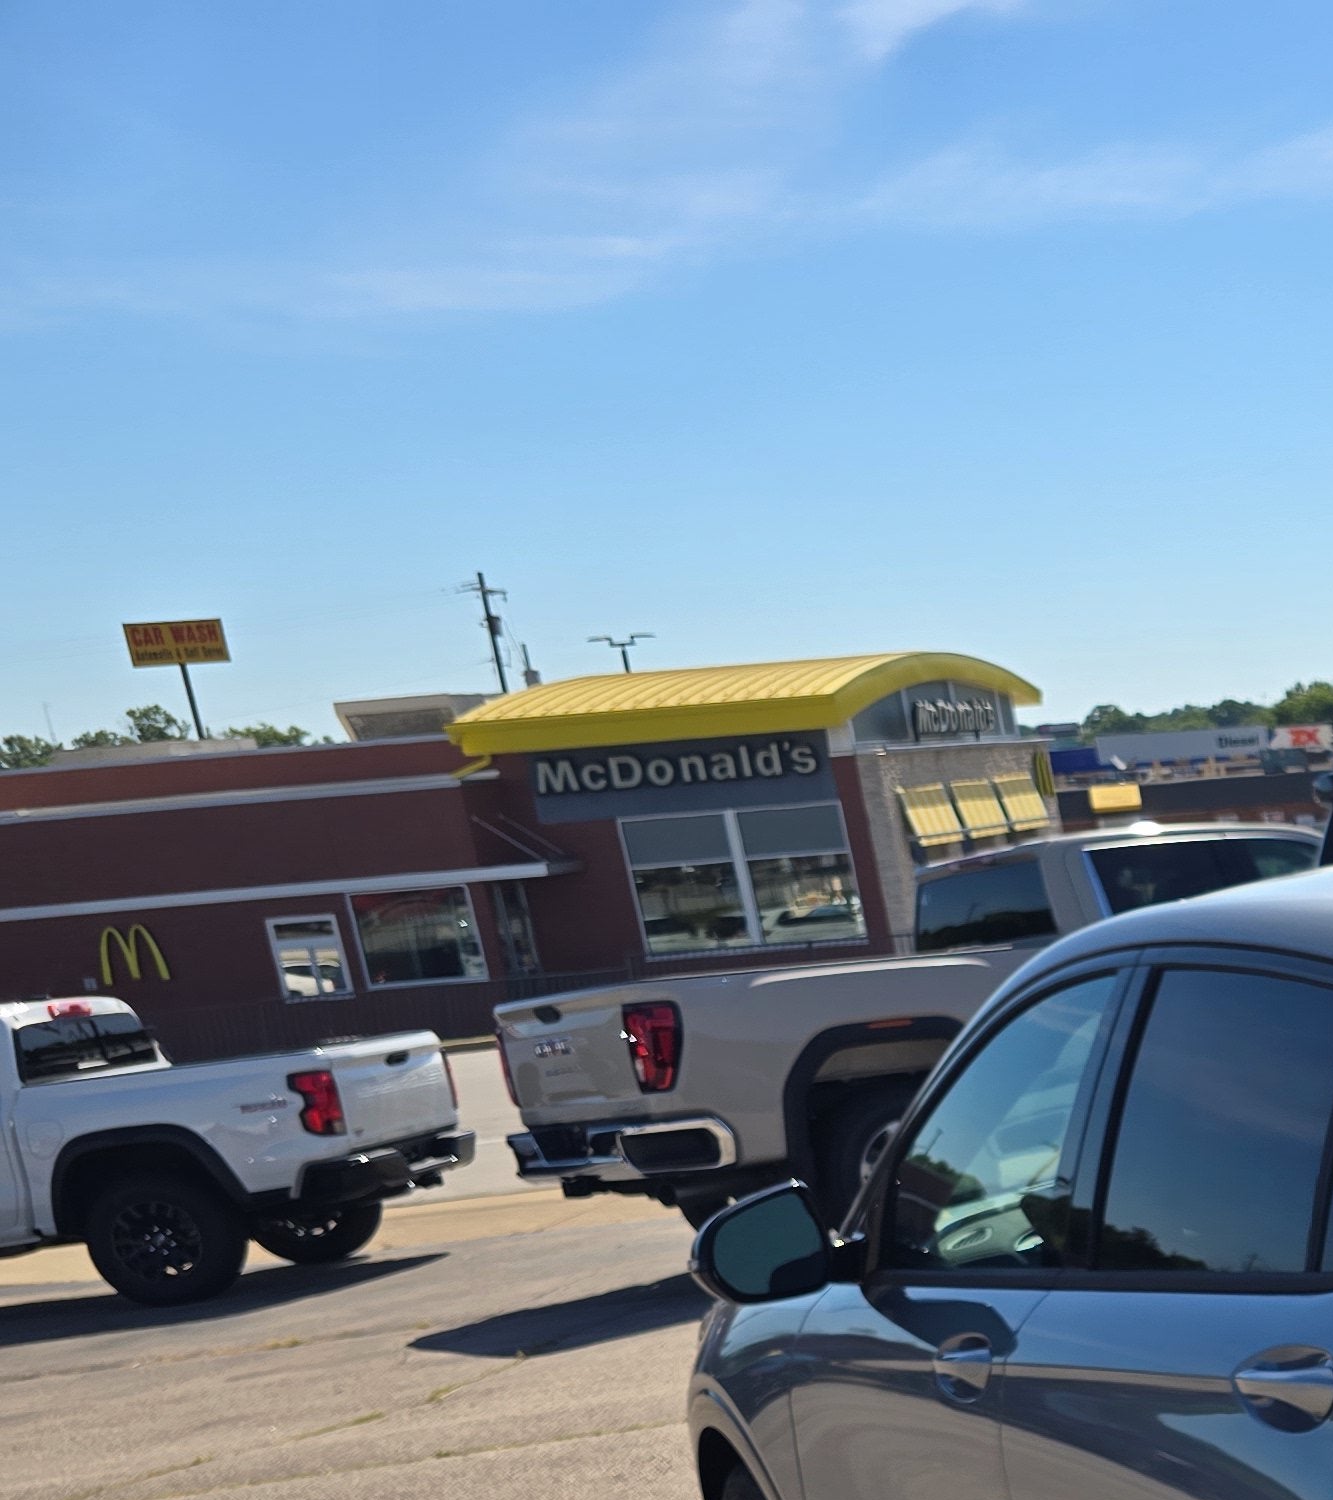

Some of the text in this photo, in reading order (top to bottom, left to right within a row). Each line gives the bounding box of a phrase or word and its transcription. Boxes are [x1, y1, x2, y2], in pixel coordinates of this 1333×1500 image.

[129, 622, 219, 647] CAR WASH
[914, 698, 997, 736] McDonald's
[1217, 735, 1260, 748] Diesel
[536, 740, 817, 794] McDonald's
